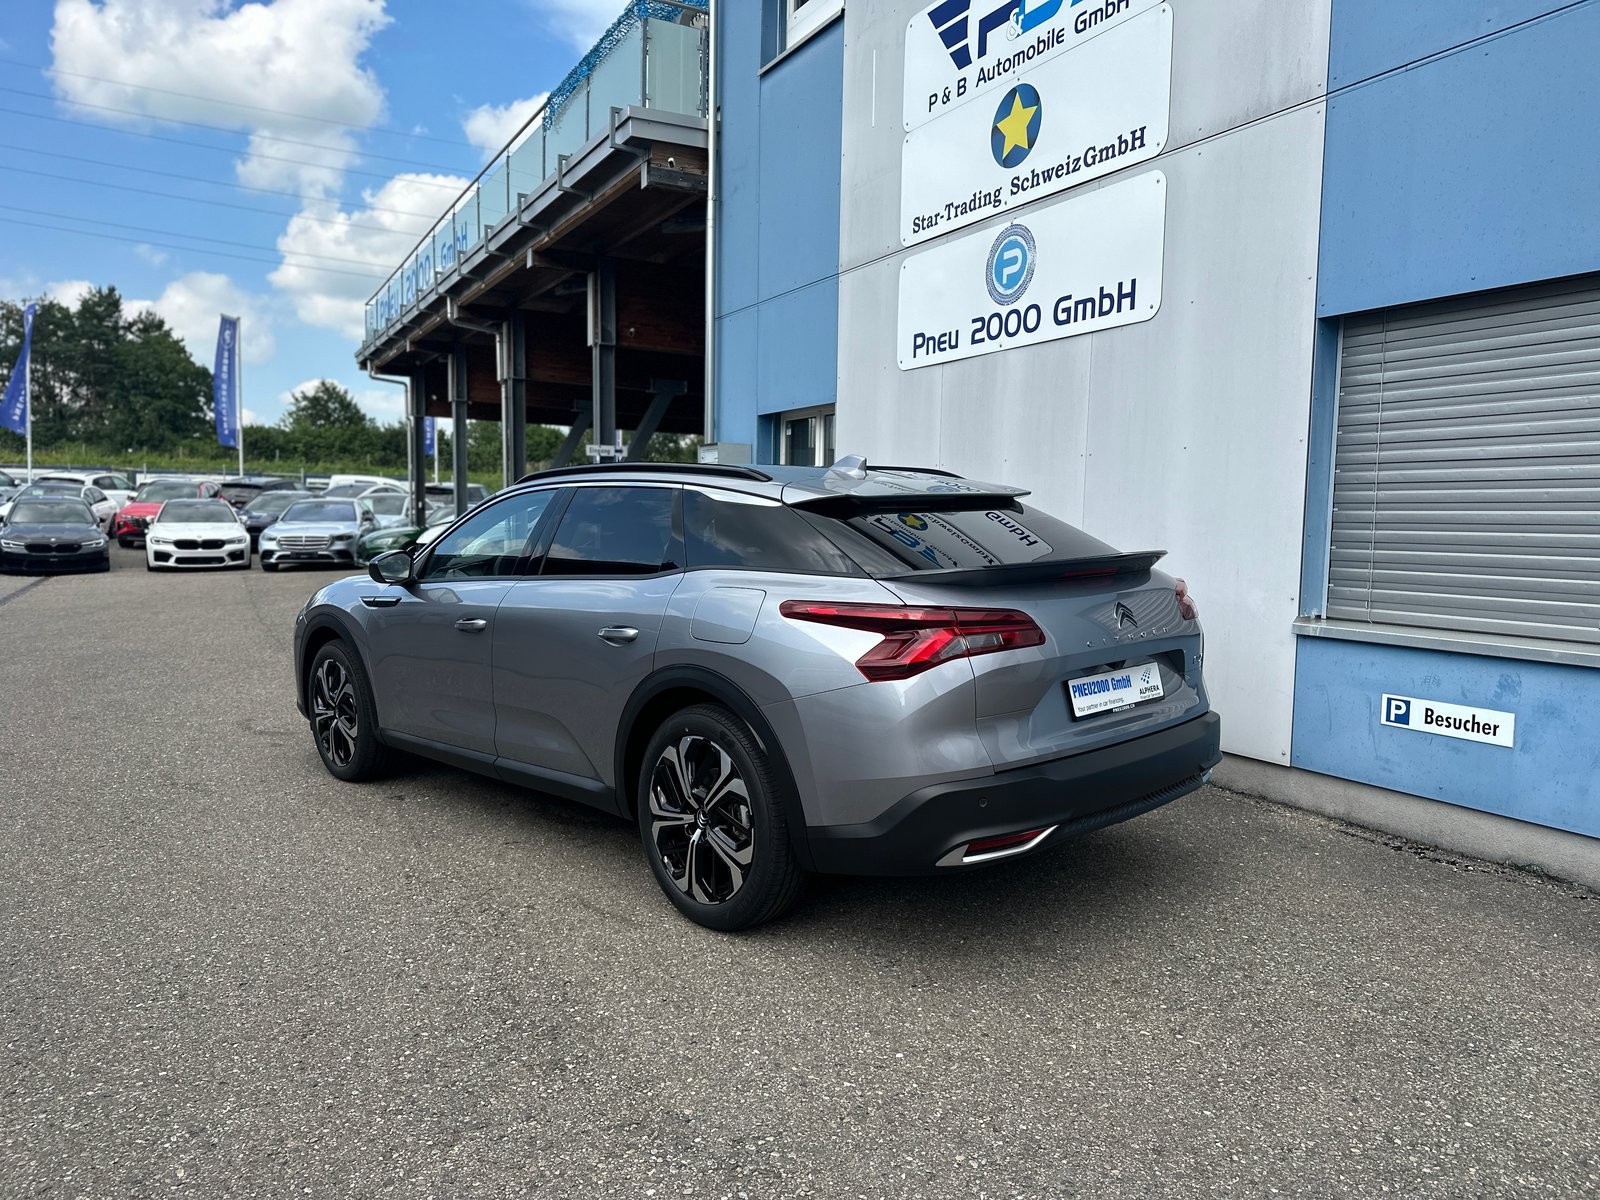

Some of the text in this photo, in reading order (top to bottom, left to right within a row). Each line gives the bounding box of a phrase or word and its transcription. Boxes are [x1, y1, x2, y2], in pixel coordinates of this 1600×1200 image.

[928, 93, 938, 113] P
[941, 86, 951, 105] &
[956, 77, 967, 99] B
[975, 27, 1065, 88] Automobile
[912, 187, 1002, 235] Star-Trading
[913, 278, 1137, 359] Pneu 2000 GmbH
[1071, 674, 1132, 699] PNEU2000 GmbH
[1139, 685, 1160, 695] ALPHERA
[1389, 699, 1500, 737] P Besucher
